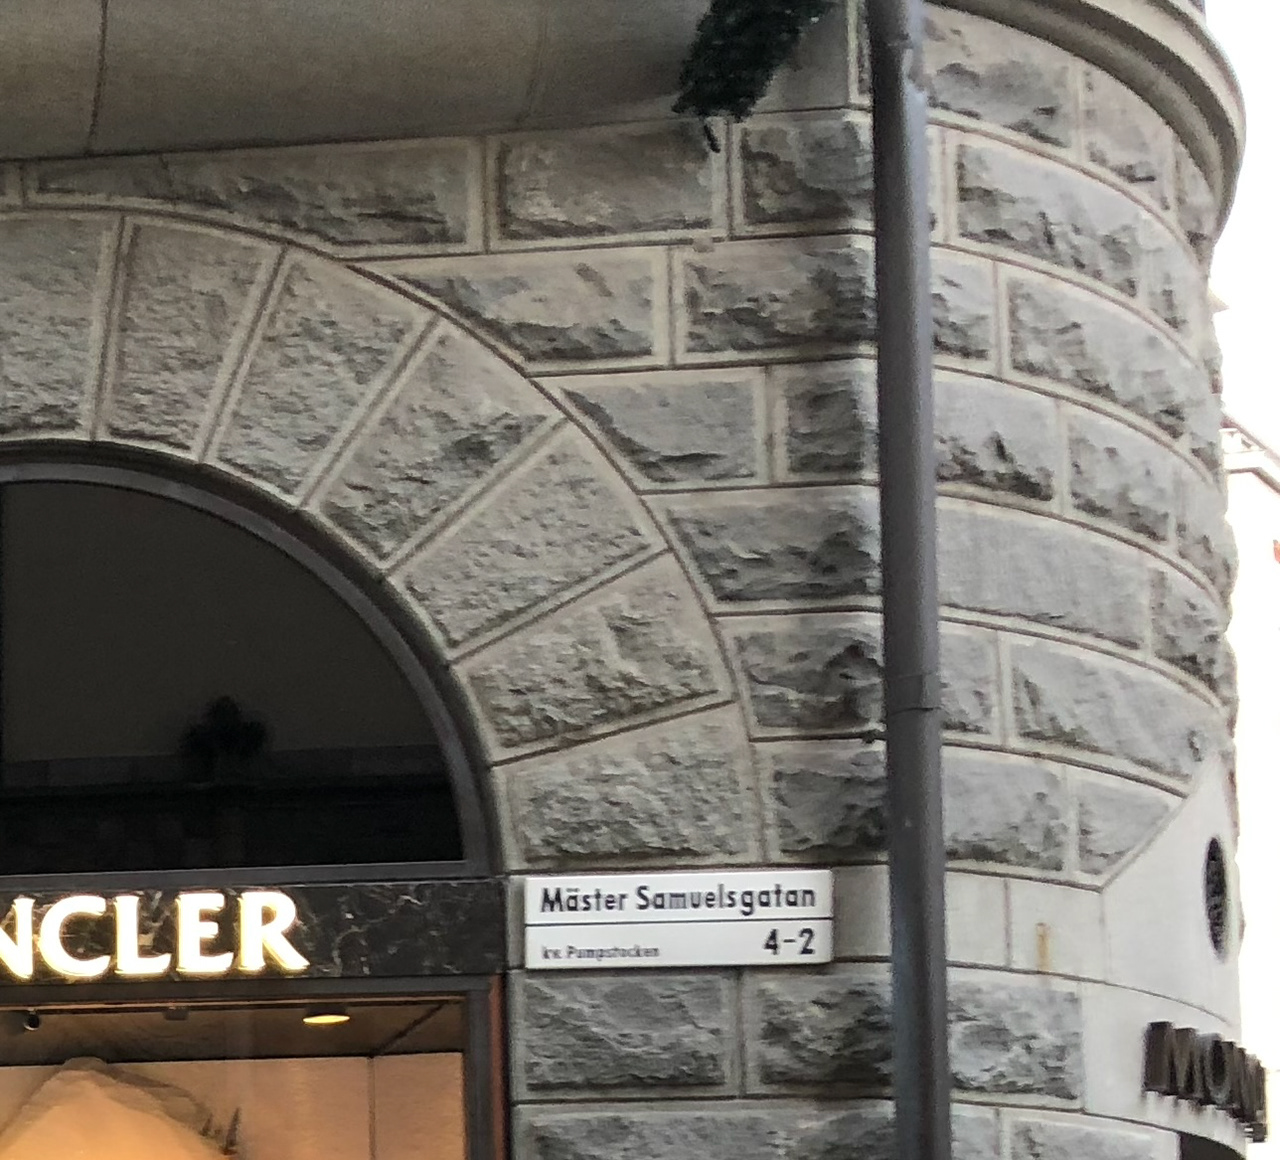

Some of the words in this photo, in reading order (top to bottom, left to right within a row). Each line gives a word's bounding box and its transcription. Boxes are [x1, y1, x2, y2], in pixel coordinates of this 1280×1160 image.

[541, 885, 626, 913] Mäster
[635, 882, 816, 916] Samuelsgatan
[764, 927, 815, 955] 4-2
